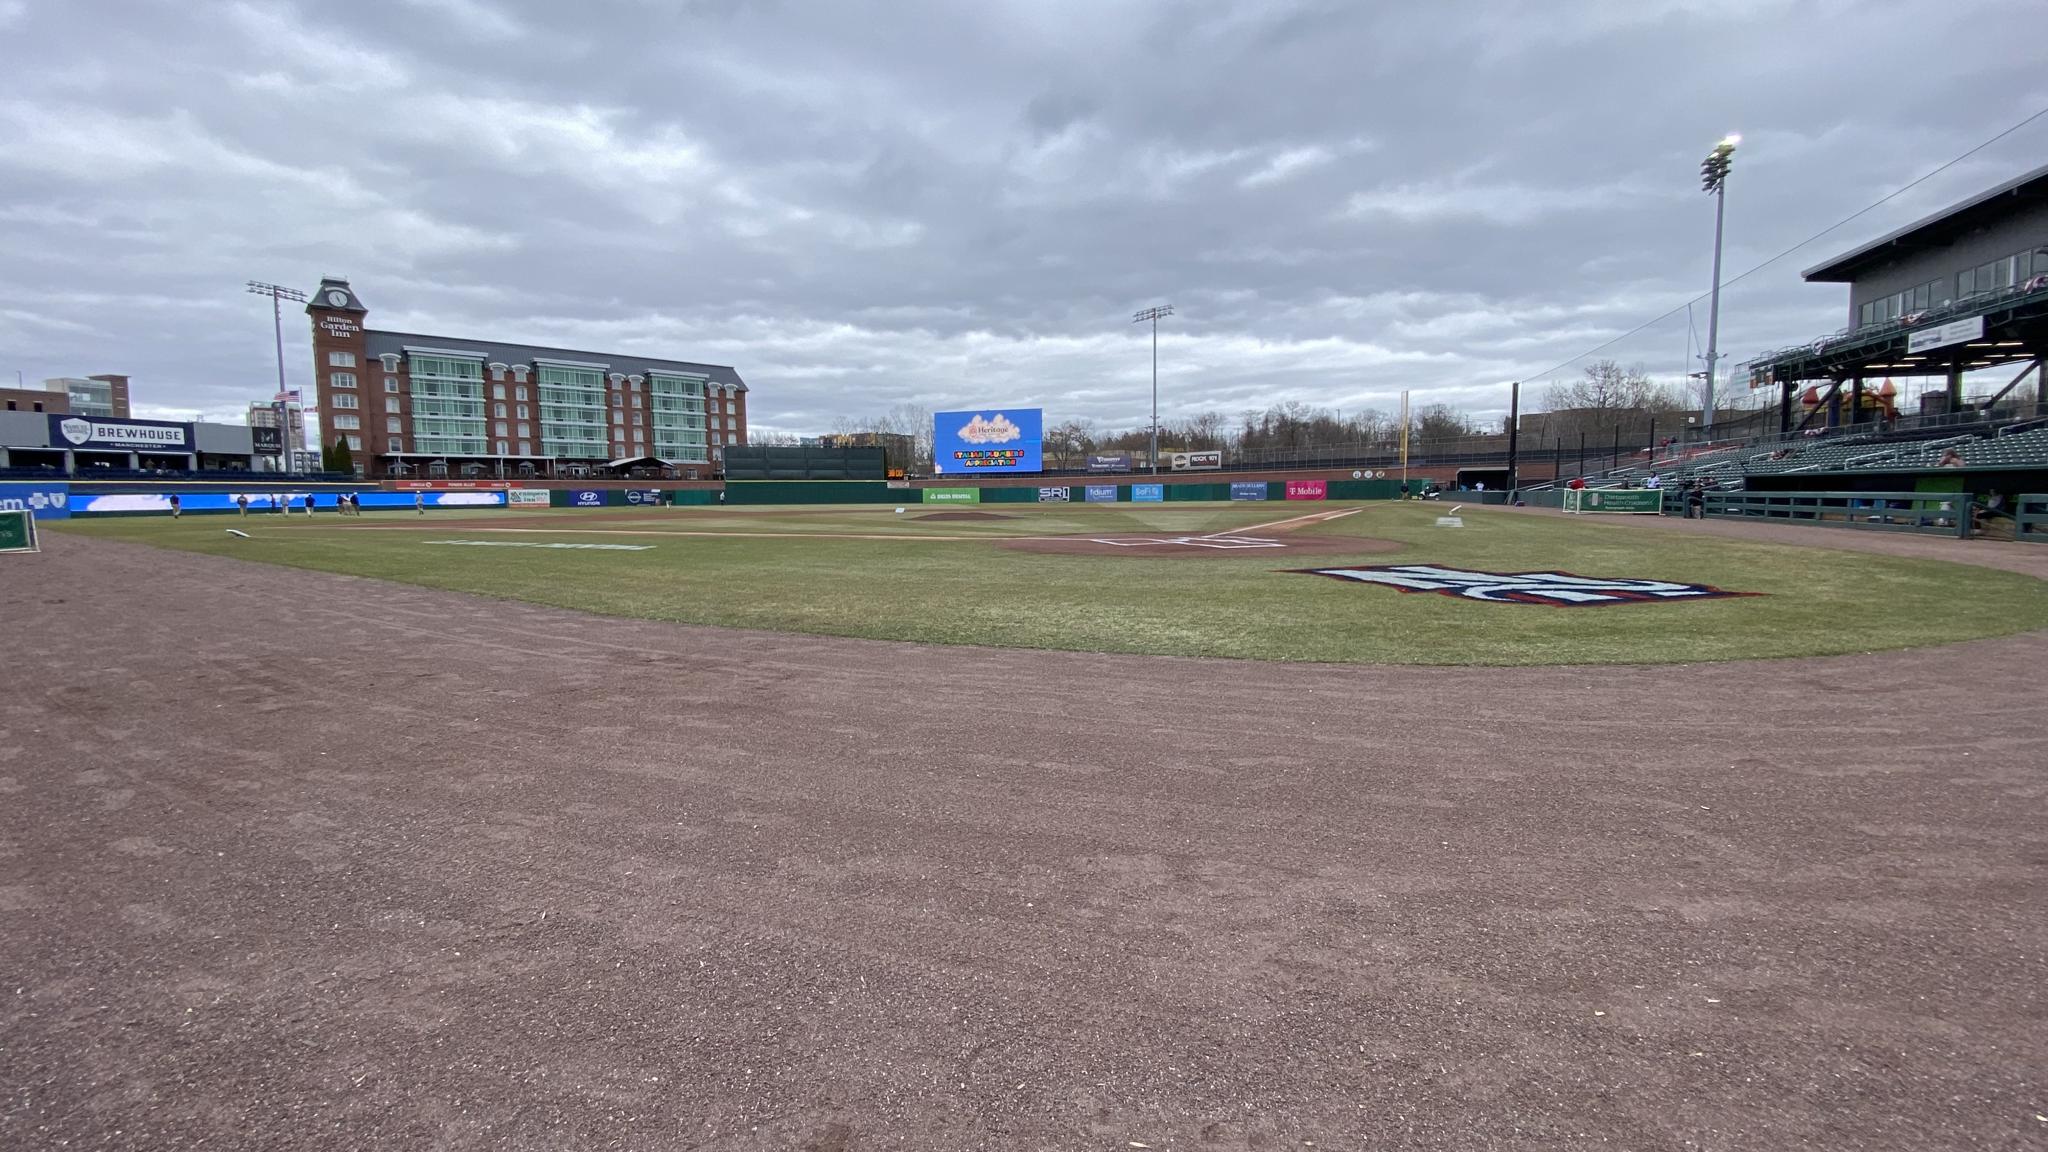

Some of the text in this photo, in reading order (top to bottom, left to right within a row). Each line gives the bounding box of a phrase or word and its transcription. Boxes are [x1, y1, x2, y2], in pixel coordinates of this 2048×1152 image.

[326, 315, 353, 324] Hilton
[320, 320, 360, 331] Garden
[331, 329, 351, 338] Inn
[98, 427, 181, 440] BREWHOUSE
[978, 426, 1009, 434] Heritage
[954, 450, 1024, 459] ITALIAN PLUMBERS
[965, 459, 1016, 467] APPRECIATION
[1297, 487, 1322, 495] Mobile
